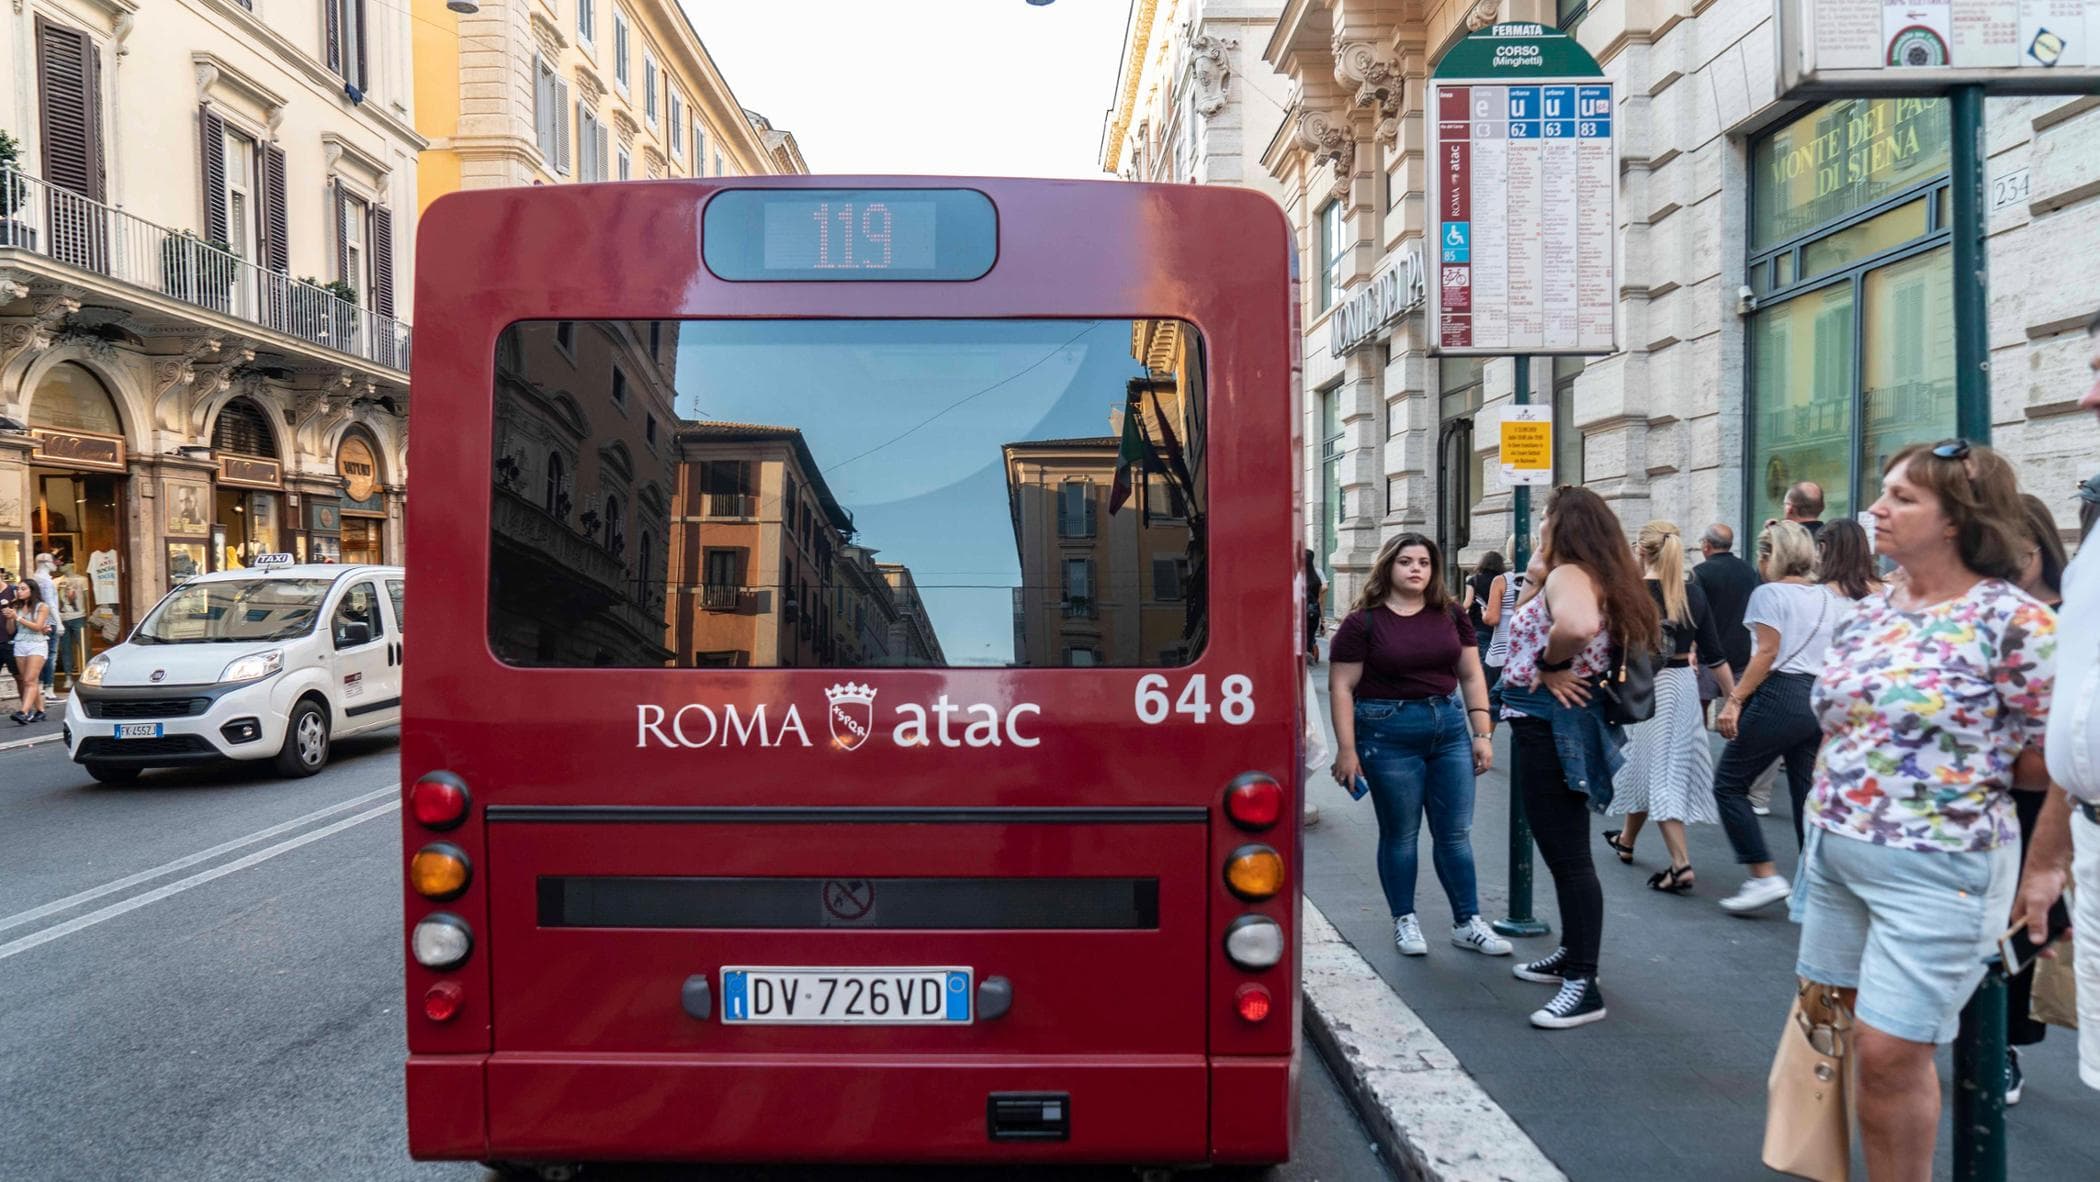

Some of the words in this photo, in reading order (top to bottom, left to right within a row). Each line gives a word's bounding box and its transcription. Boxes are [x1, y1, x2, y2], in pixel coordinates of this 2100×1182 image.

[1492, 25, 1543, 36] FERMATA
[1496, 45, 1539, 56] CORSO
[1493, 56, 1543, 67] (Minghetti)
[1476, 100, 1488, 117] e
[1511, 99, 1525, 117] u
[1546, 99, 1560, 117] u
[1581, 99, 1595, 117] u
[1476, 123, 1491, 137] C3
[1510, 123, 1526, 137] 62
[1546, 123, 1561, 136] 63
[1581, 122, 1597, 136] 83
[1772, 128, 1840, 184] MONTE
[1848, 104, 1885, 149] DEI
[1451, 144, 1460, 171] atac
[1816, 162, 1840, 197] DI
[1848, 126, 1920, 184] SIENA
[814, 203, 892, 269] 119
[259, 554, 288, 564] TAXI
[1134, 674, 1255, 725] 648
[636, 702, 813, 748] ROMA
[838, 710, 866, 737] SPQR
[892, 694, 1041, 748] atac
[754, 978, 799, 1016] DV
[818, 978, 943, 1016] 726VD
